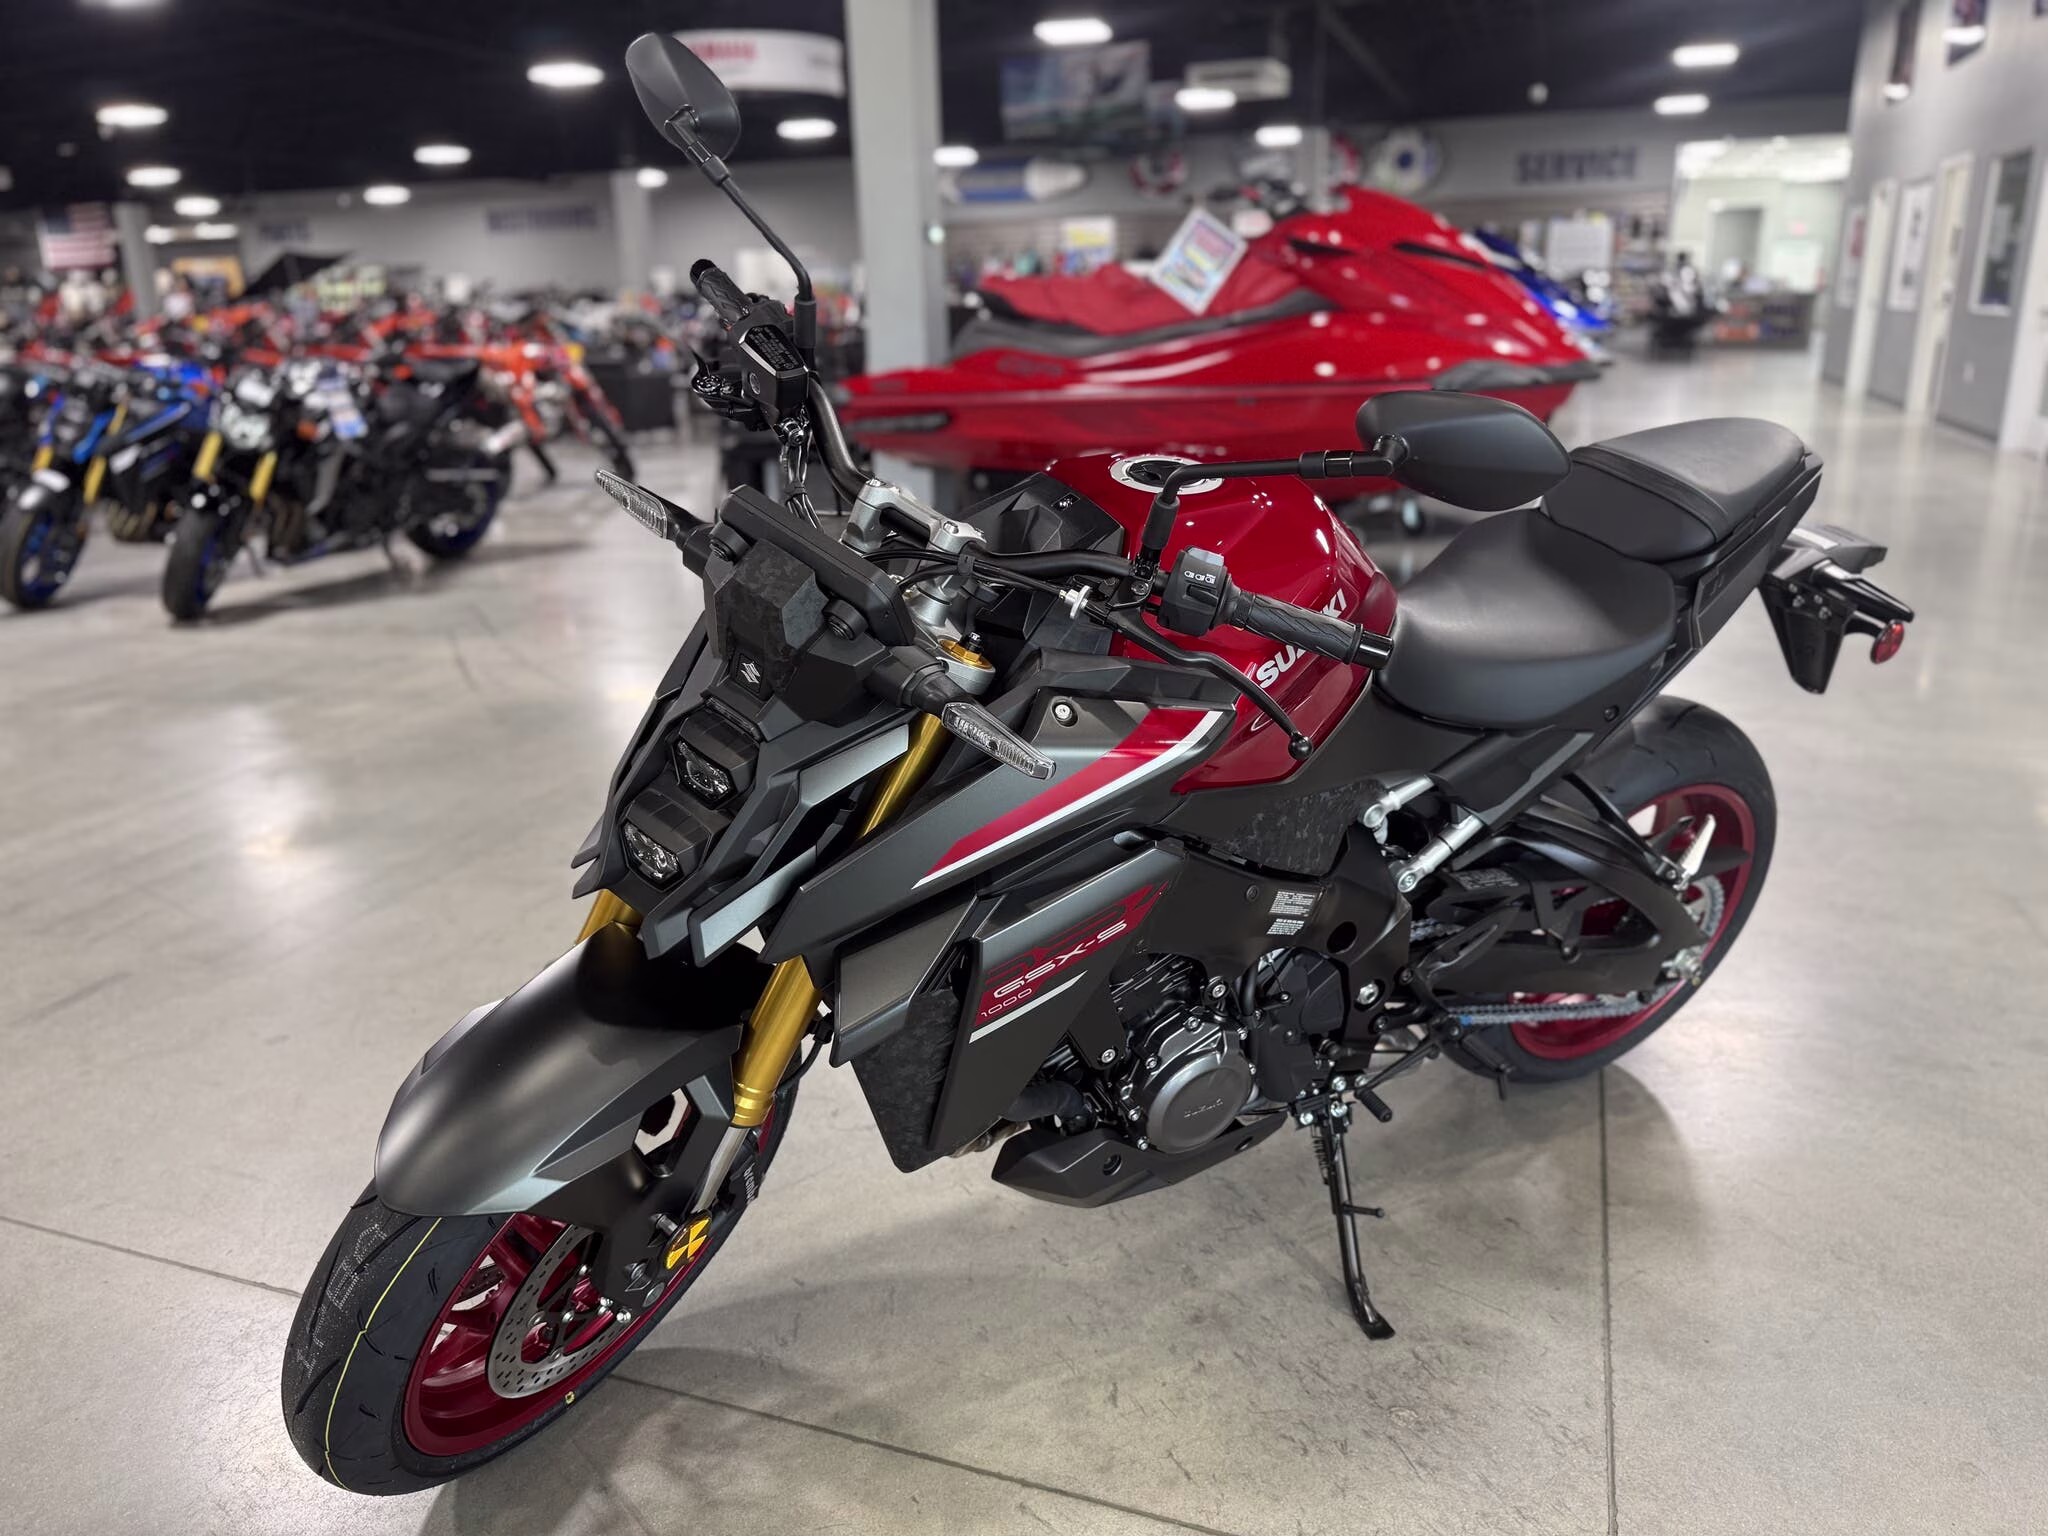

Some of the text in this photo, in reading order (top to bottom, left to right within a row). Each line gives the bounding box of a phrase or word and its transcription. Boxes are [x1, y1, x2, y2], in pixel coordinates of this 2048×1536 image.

[1256, 588, 1347, 689] SUKI
[994, 919, 1128, 999] GSX-S
[981, 988, 1033, 1017] 1000
